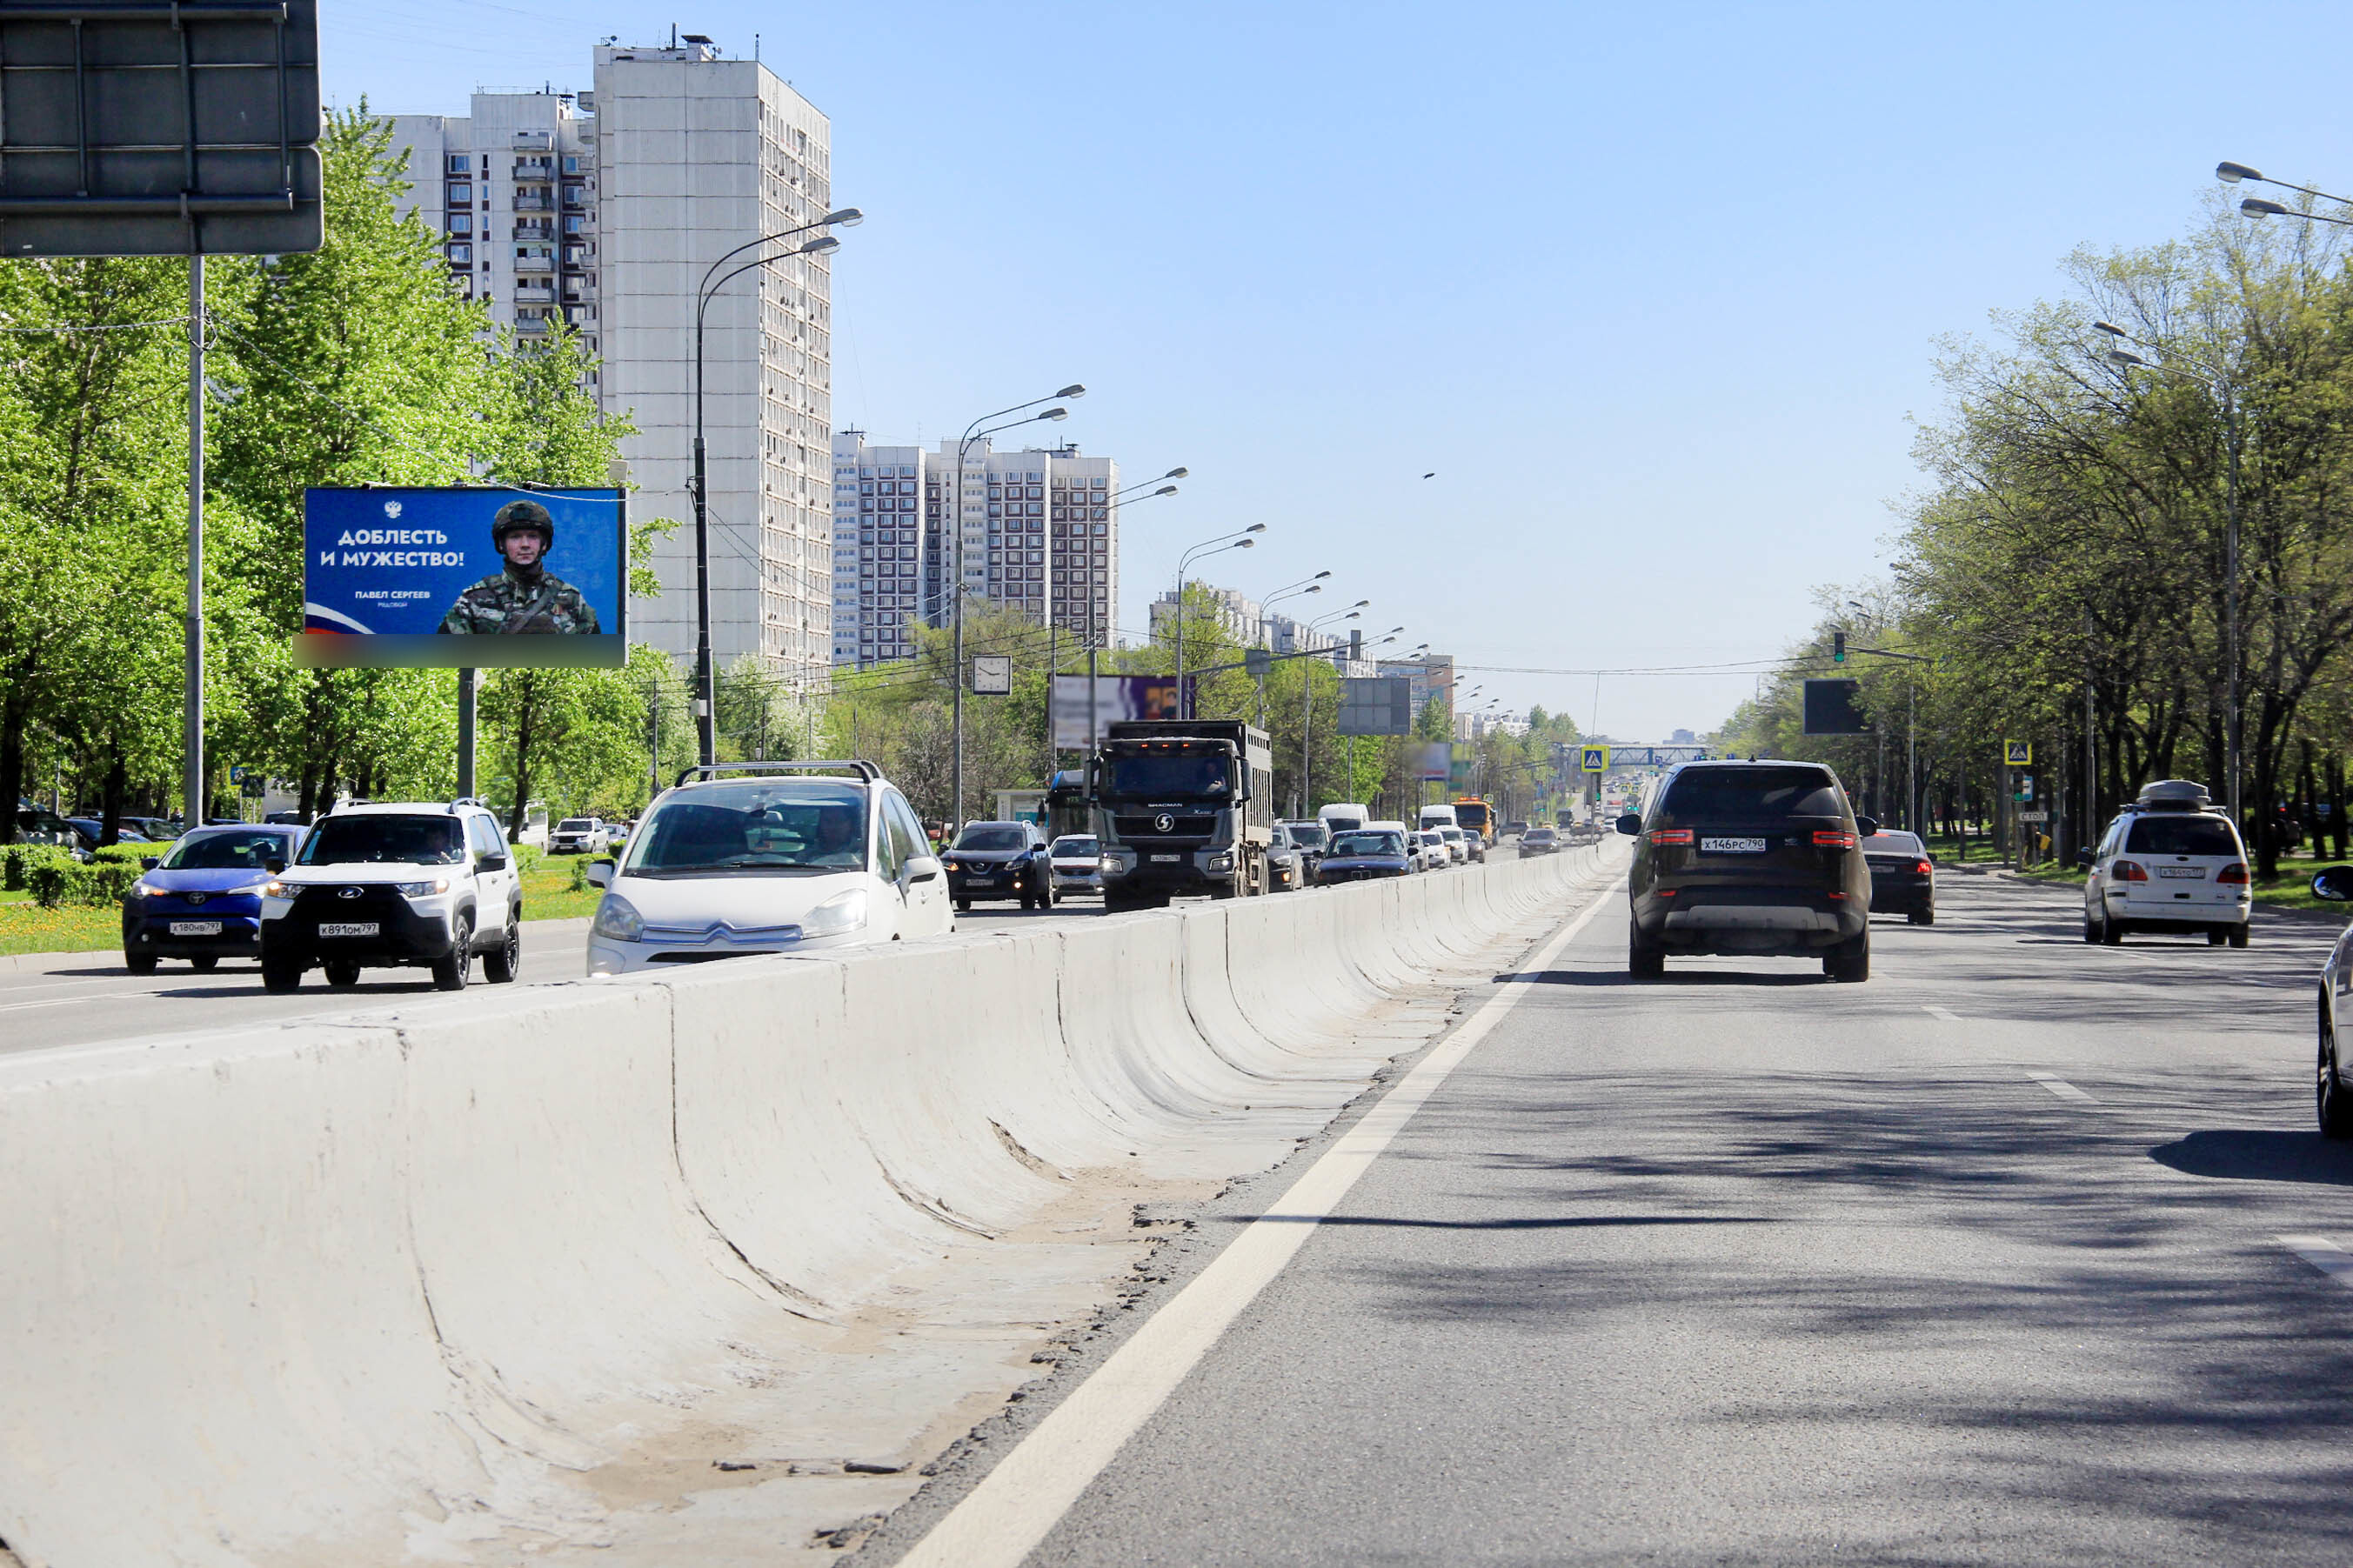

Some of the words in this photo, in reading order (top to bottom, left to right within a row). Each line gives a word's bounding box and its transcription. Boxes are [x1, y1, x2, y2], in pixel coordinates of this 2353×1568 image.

[338, 529, 448, 546] ДОБЛЕСТЬ
[320, 550, 335, 566] И
[343, 551, 465, 566] МУЖЕСТВО!
[355, 591, 388, 599] ПАВЕЛ
[391, 591, 431, 599] СЕРГЕЕВ
